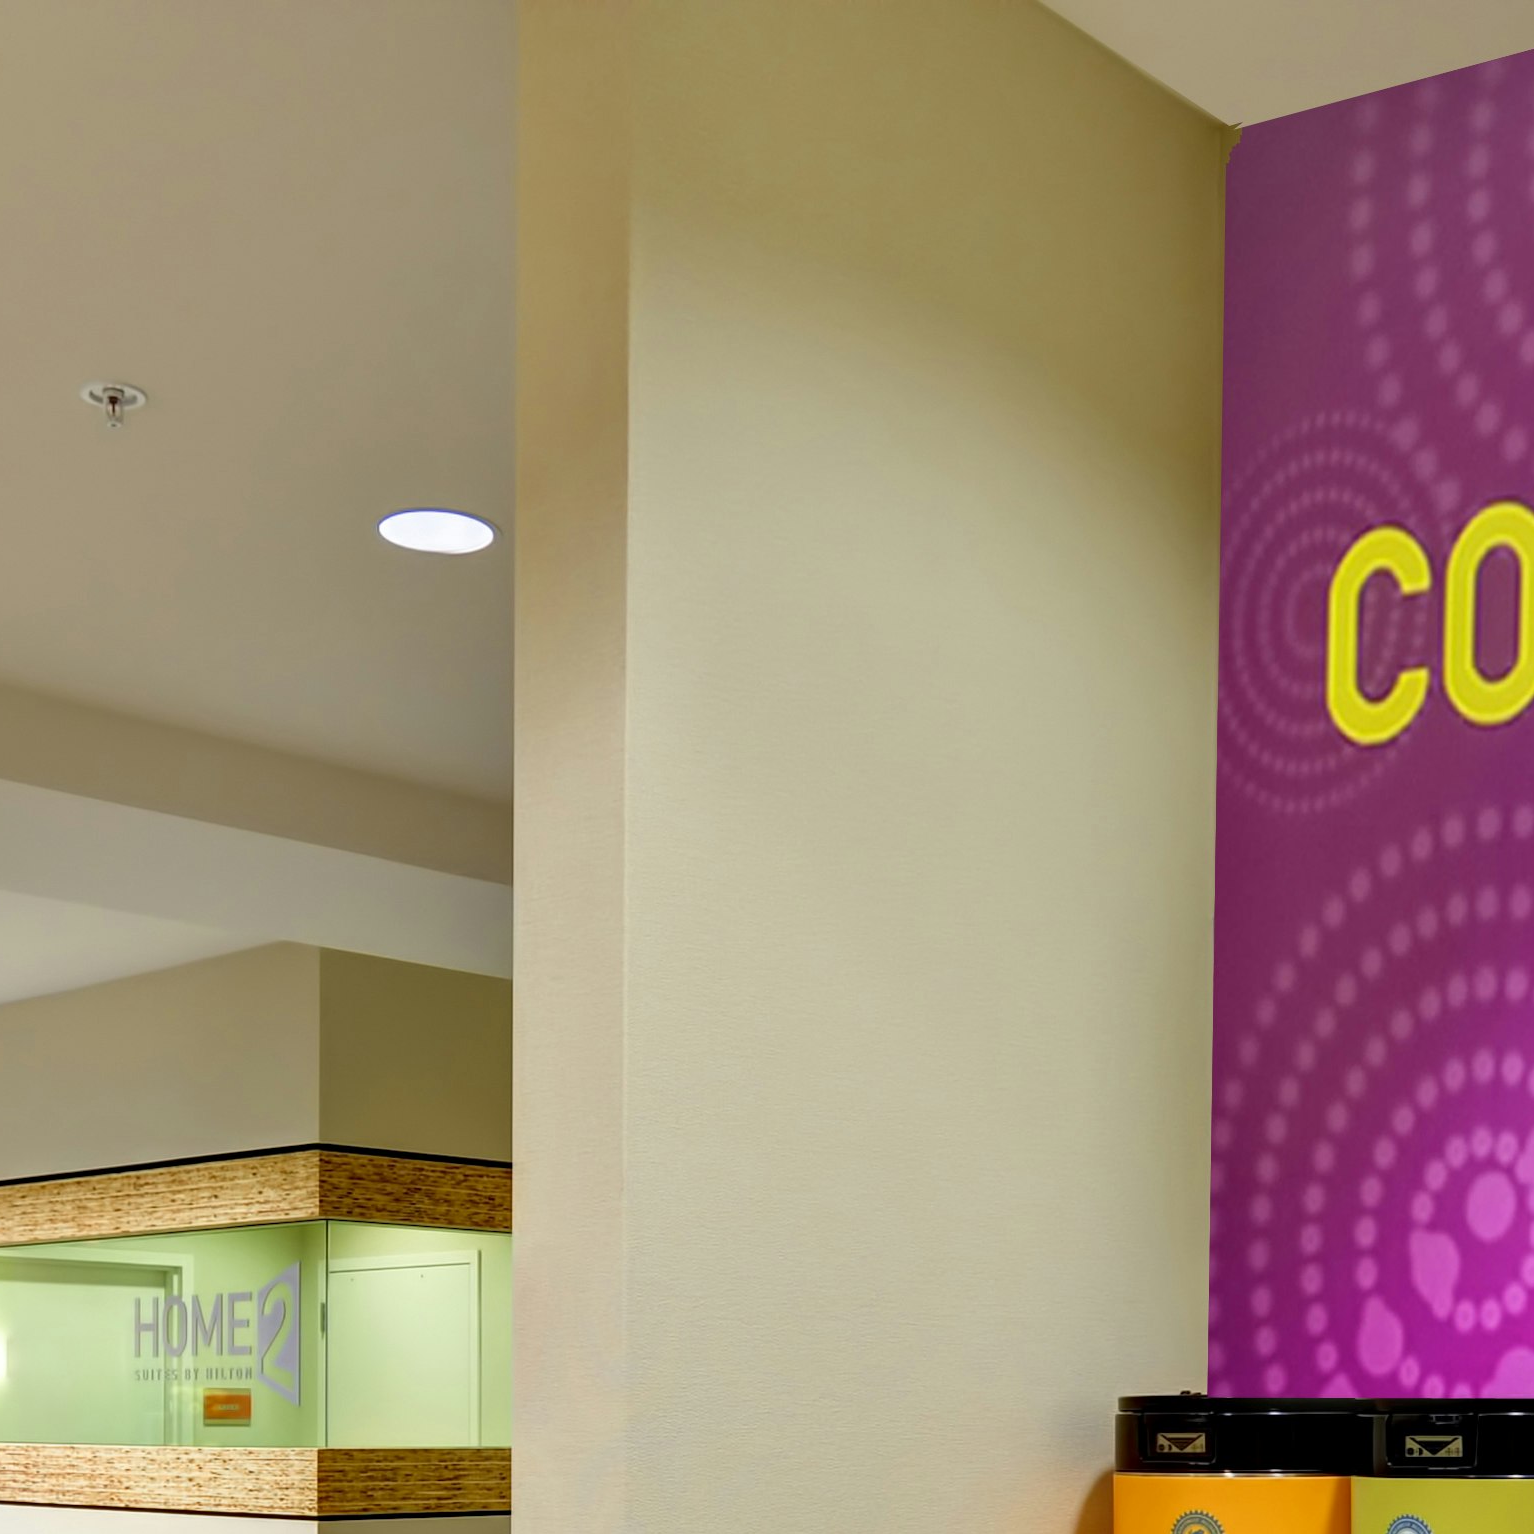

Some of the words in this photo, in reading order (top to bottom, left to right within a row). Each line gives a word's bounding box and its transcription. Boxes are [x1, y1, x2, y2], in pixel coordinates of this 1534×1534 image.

[134, 1291, 253, 1359] HOME
[260, 1272, 298, 1398] 2
[134, 1368, 178, 1381] SUITES
[184, 1367, 199, 1381] BY
[205, 1367, 253, 1380] HILTON
